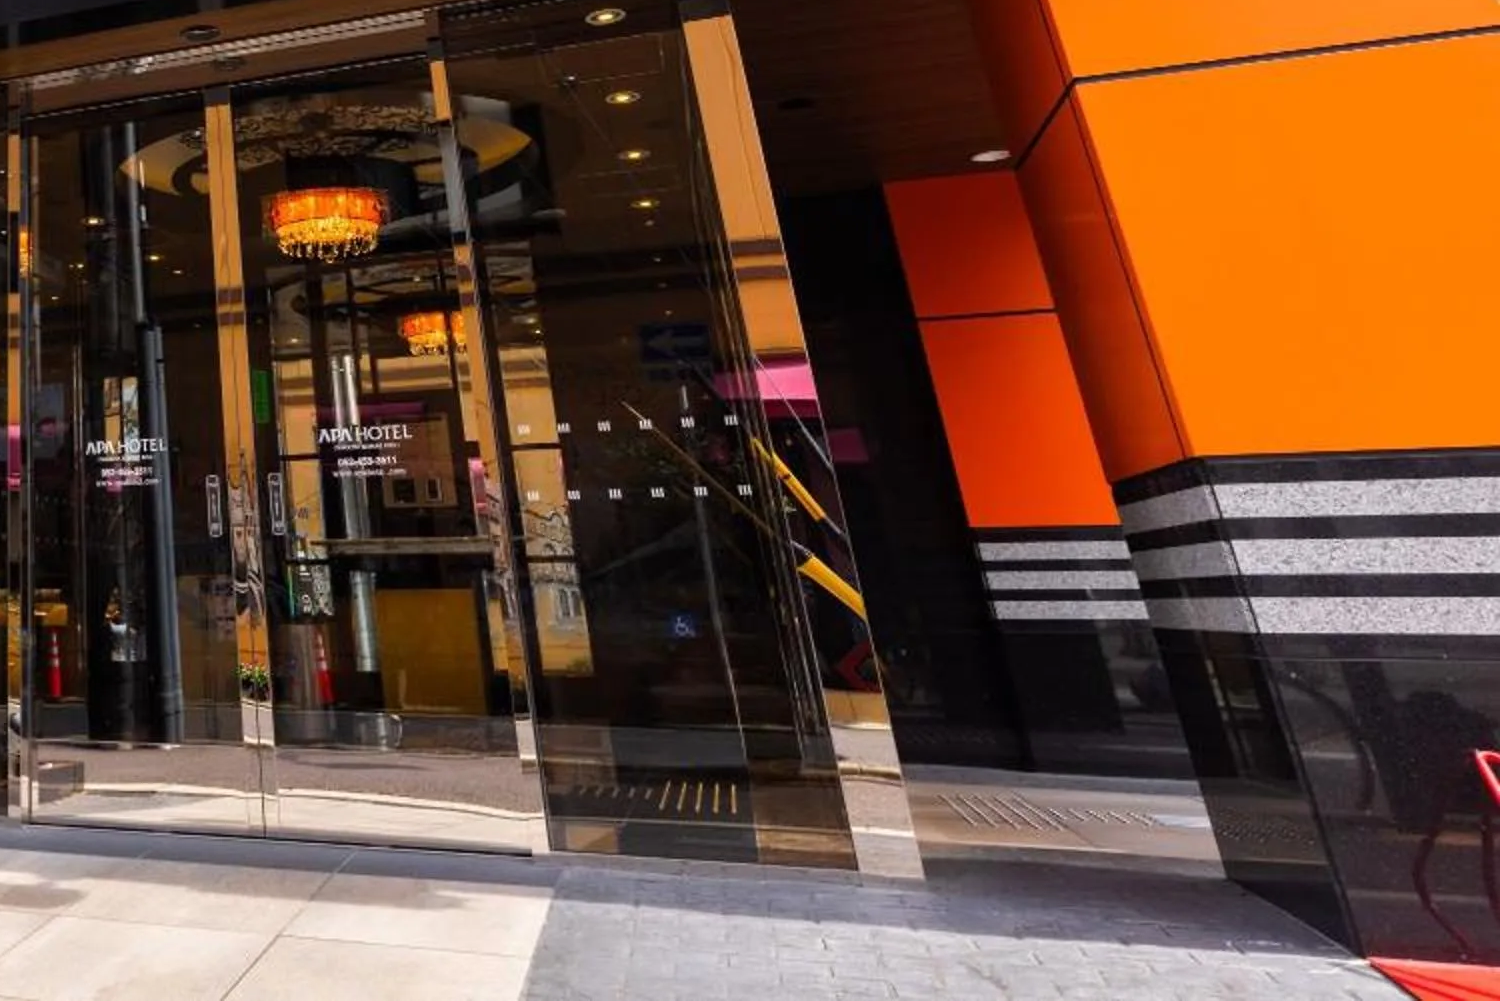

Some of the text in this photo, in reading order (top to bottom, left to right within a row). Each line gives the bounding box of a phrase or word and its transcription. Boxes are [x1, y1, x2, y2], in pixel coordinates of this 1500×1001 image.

[318, 423, 414, 444] APA HOTEL
[85, 437, 168, 456] APA HOTEL
